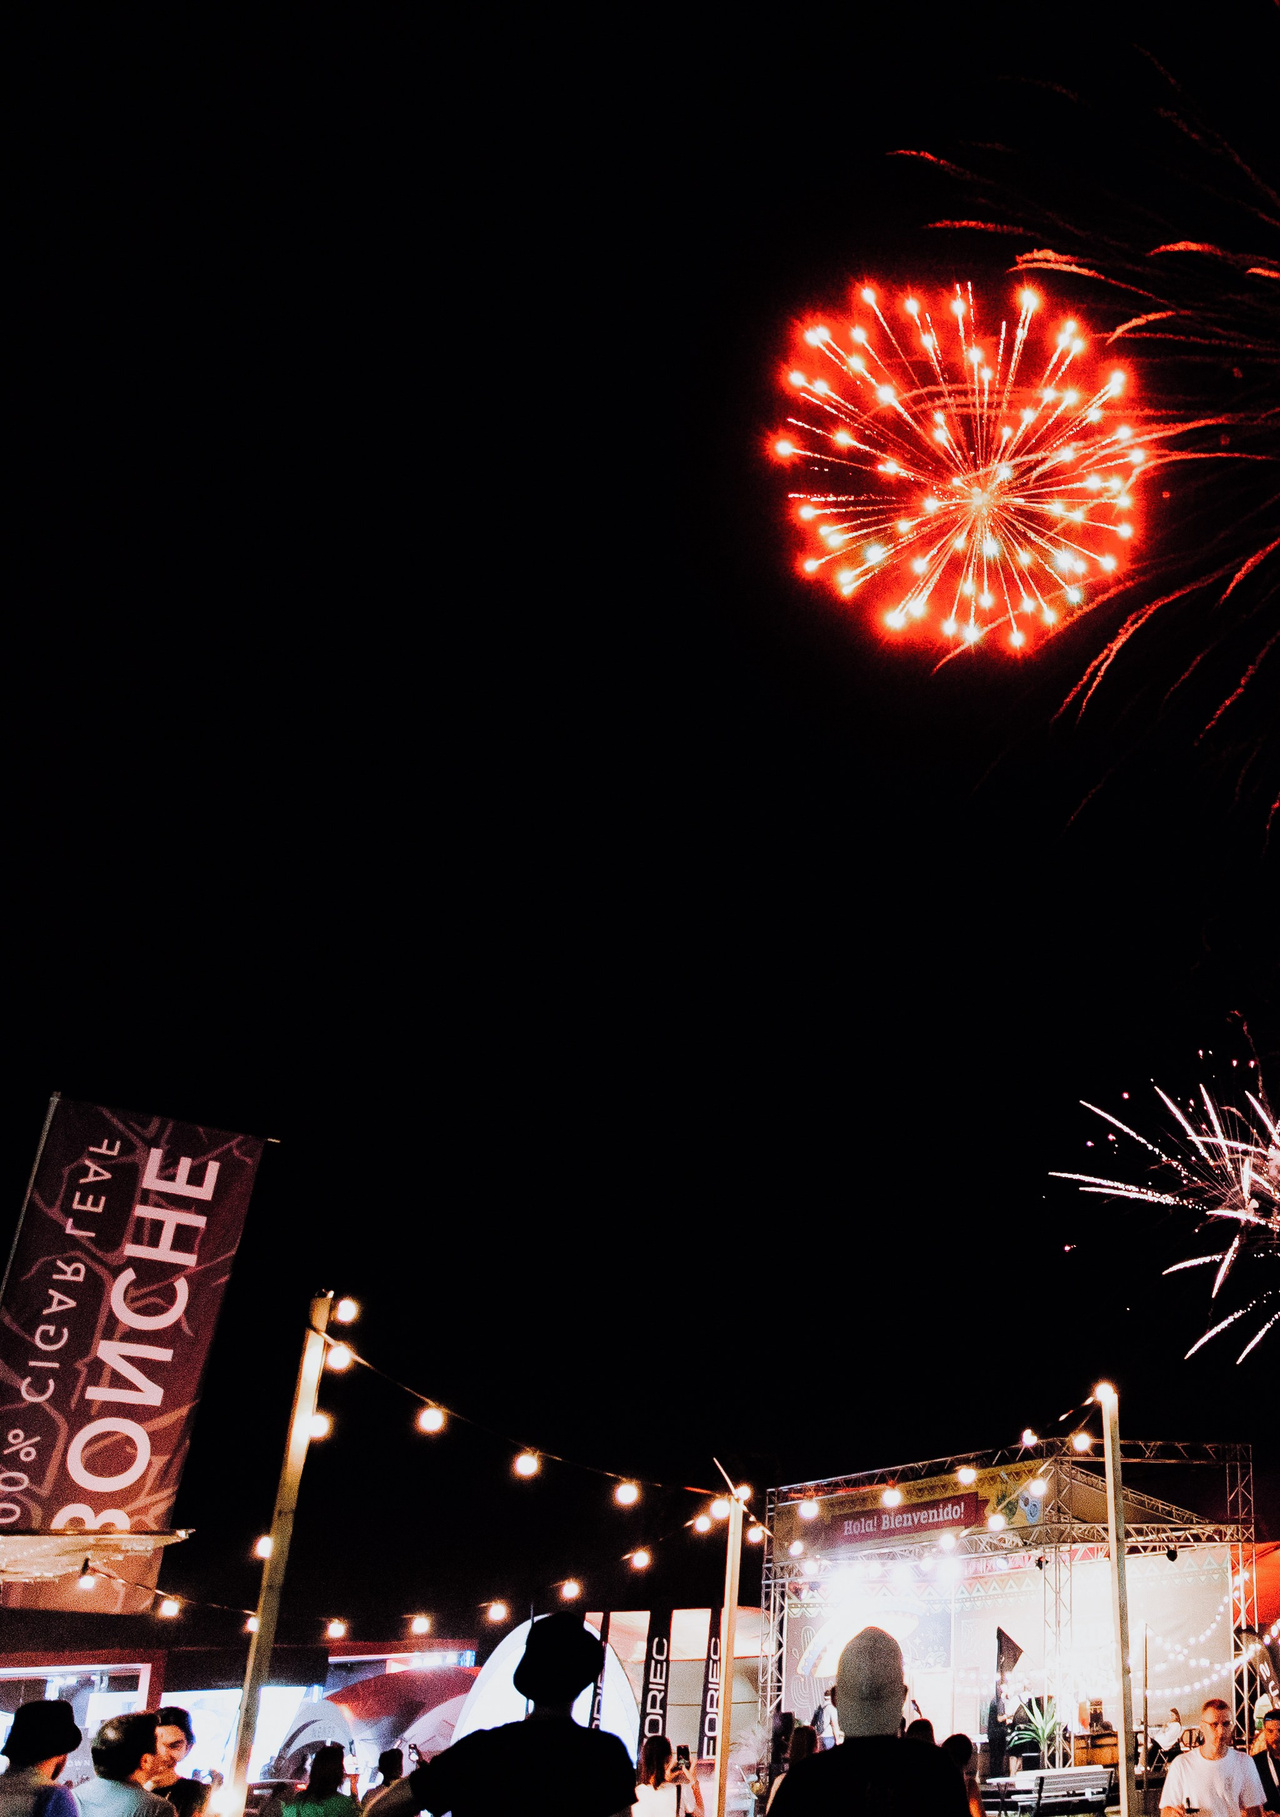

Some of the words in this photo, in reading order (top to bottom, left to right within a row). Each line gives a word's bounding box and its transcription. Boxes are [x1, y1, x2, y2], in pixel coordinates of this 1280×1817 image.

[844, 1515, 878, 1536] Hola!
[881, 1501, 965, 1531] Bienvenido!
[642, 1636, 669, 1743] ORIEC
